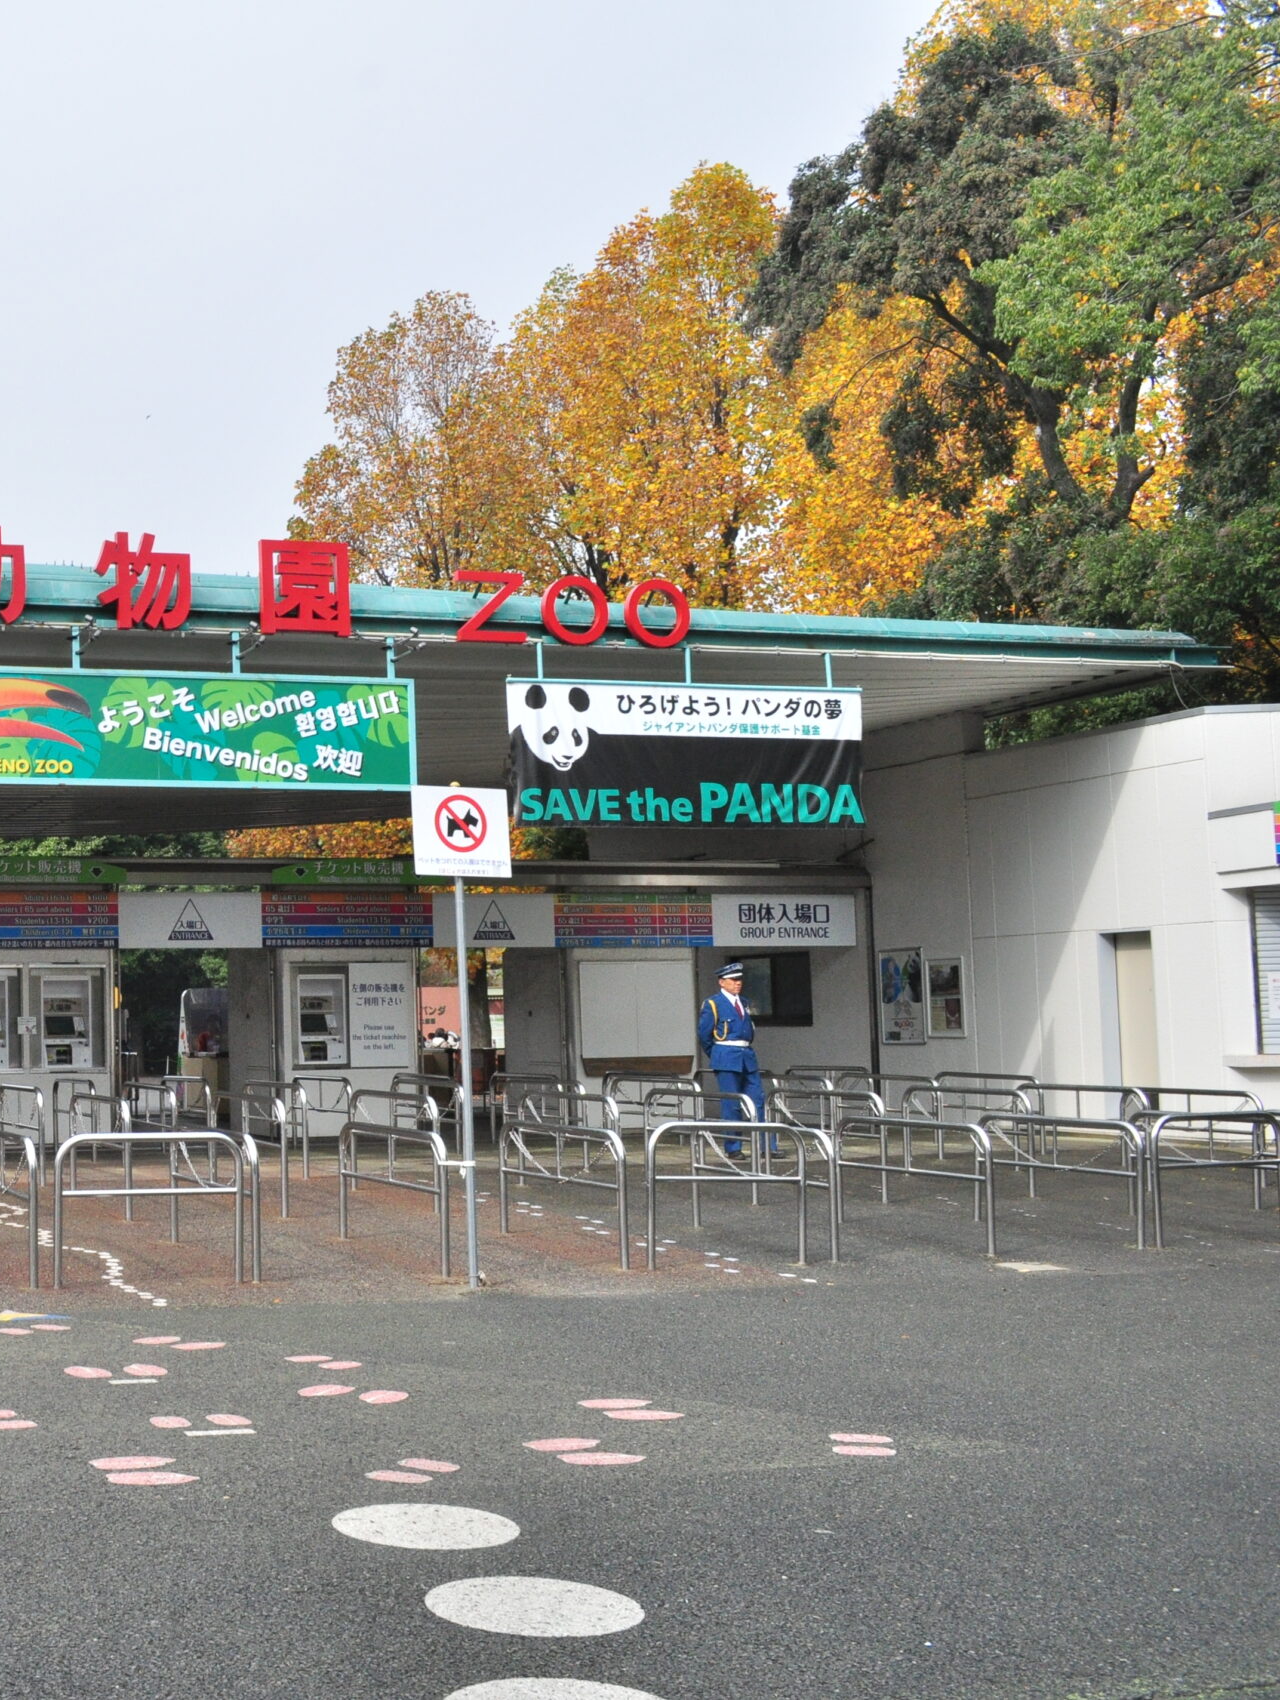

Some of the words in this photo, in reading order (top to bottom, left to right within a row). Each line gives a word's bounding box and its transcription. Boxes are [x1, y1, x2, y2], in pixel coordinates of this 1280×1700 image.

[455, 570, 690, 648] ZOO
[97, 686, 195, 733] ようこそ
[194, 689, 317, 734] Welcome
[294, 689, 401, 738] 환영합니다
[616, 694, 732, 717] ひろげよう！
[742, 698, 843, 720] パンダの夢
[643, 721, 821, 736] ジャイアントパンダ保護サポート基金
[34, 759, 74, 775] ZOO
[143, 727, 309, 782] Bienvenidos
[313, 743, 364, 777] 欢迎
[520, 787, 621, 821] SAVE
[627, 787, 693, 821] the
[699, 782, 864, 824] PANDA
[314, 862, 404, 875] チケット販売機
[738, 903, 830, 924] 団体入場口
[171, 931, 210, 940] ENTRANCE
[740, 927, 775, 938] GROUP
[778, 927, 830, 938] ENTRANCE
[356, 996, 402, 1007] ご利用下さい
